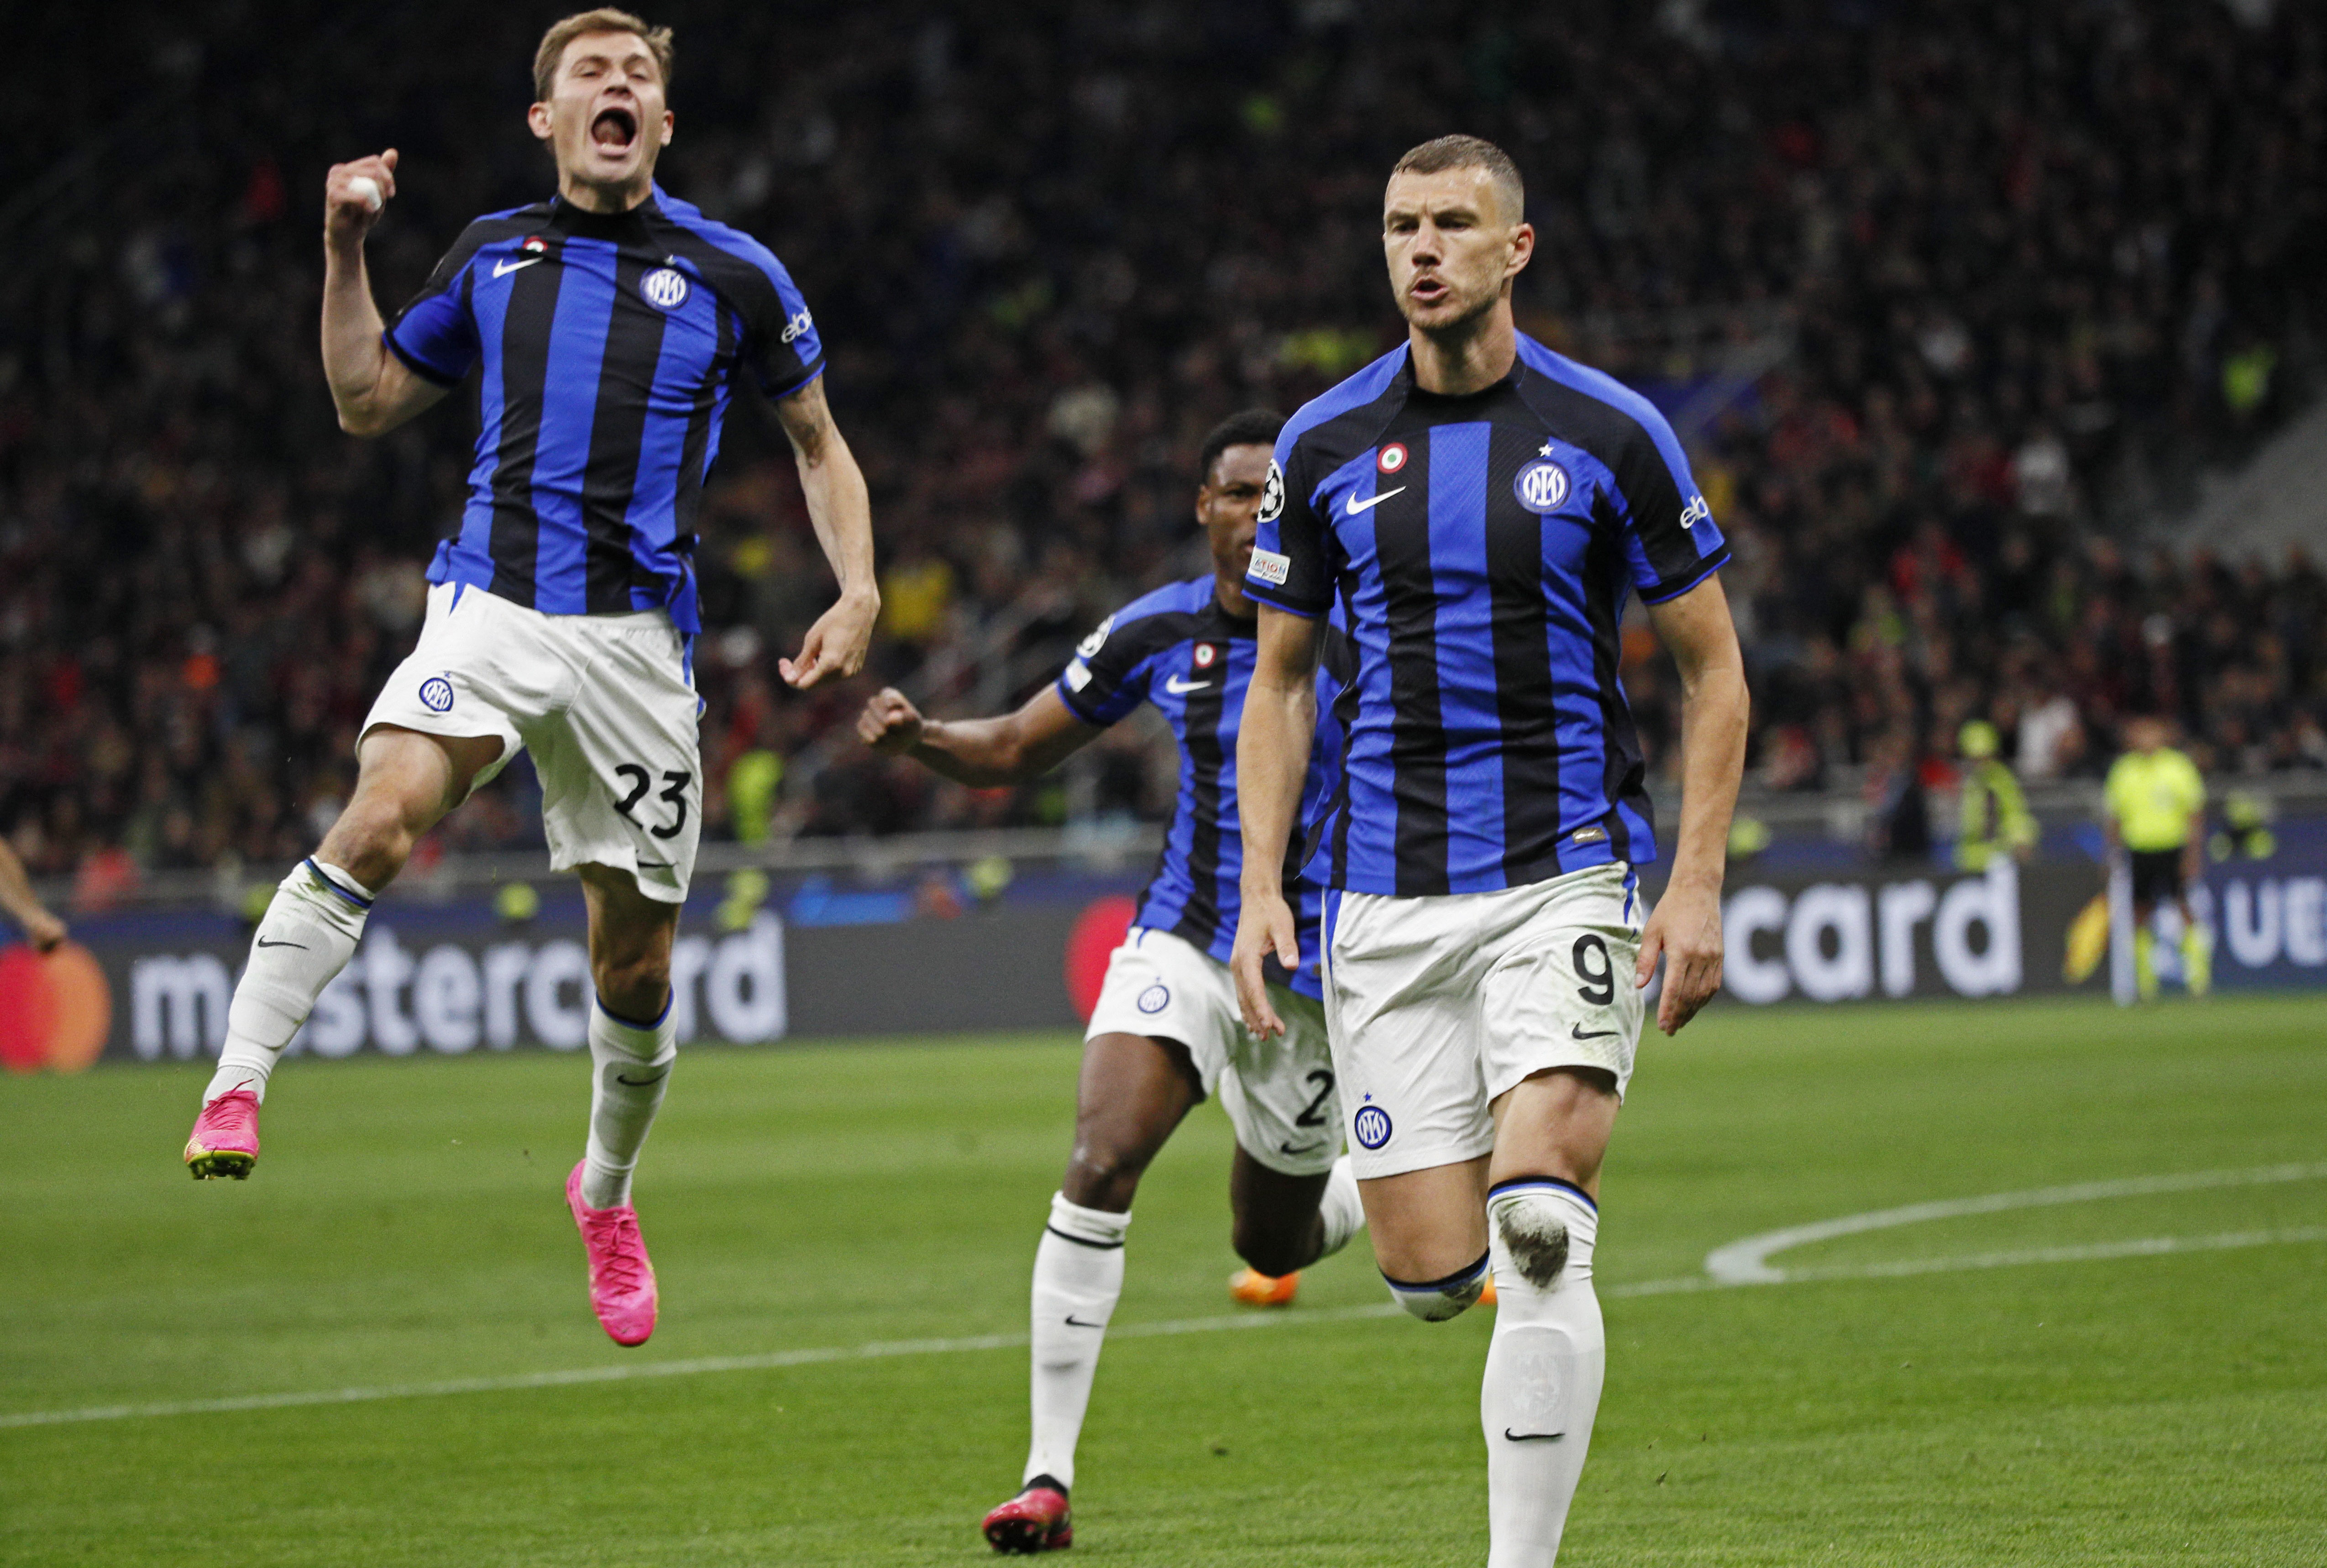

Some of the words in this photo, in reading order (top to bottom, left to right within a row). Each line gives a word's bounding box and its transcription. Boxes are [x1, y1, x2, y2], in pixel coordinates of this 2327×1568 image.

[613, 763, 692, 839] 23
[130, 908, 787, 1061] mstercrd
[1572, 934, 1614, 1006] 9
[1295, 1069, 1335, 1127] 2
